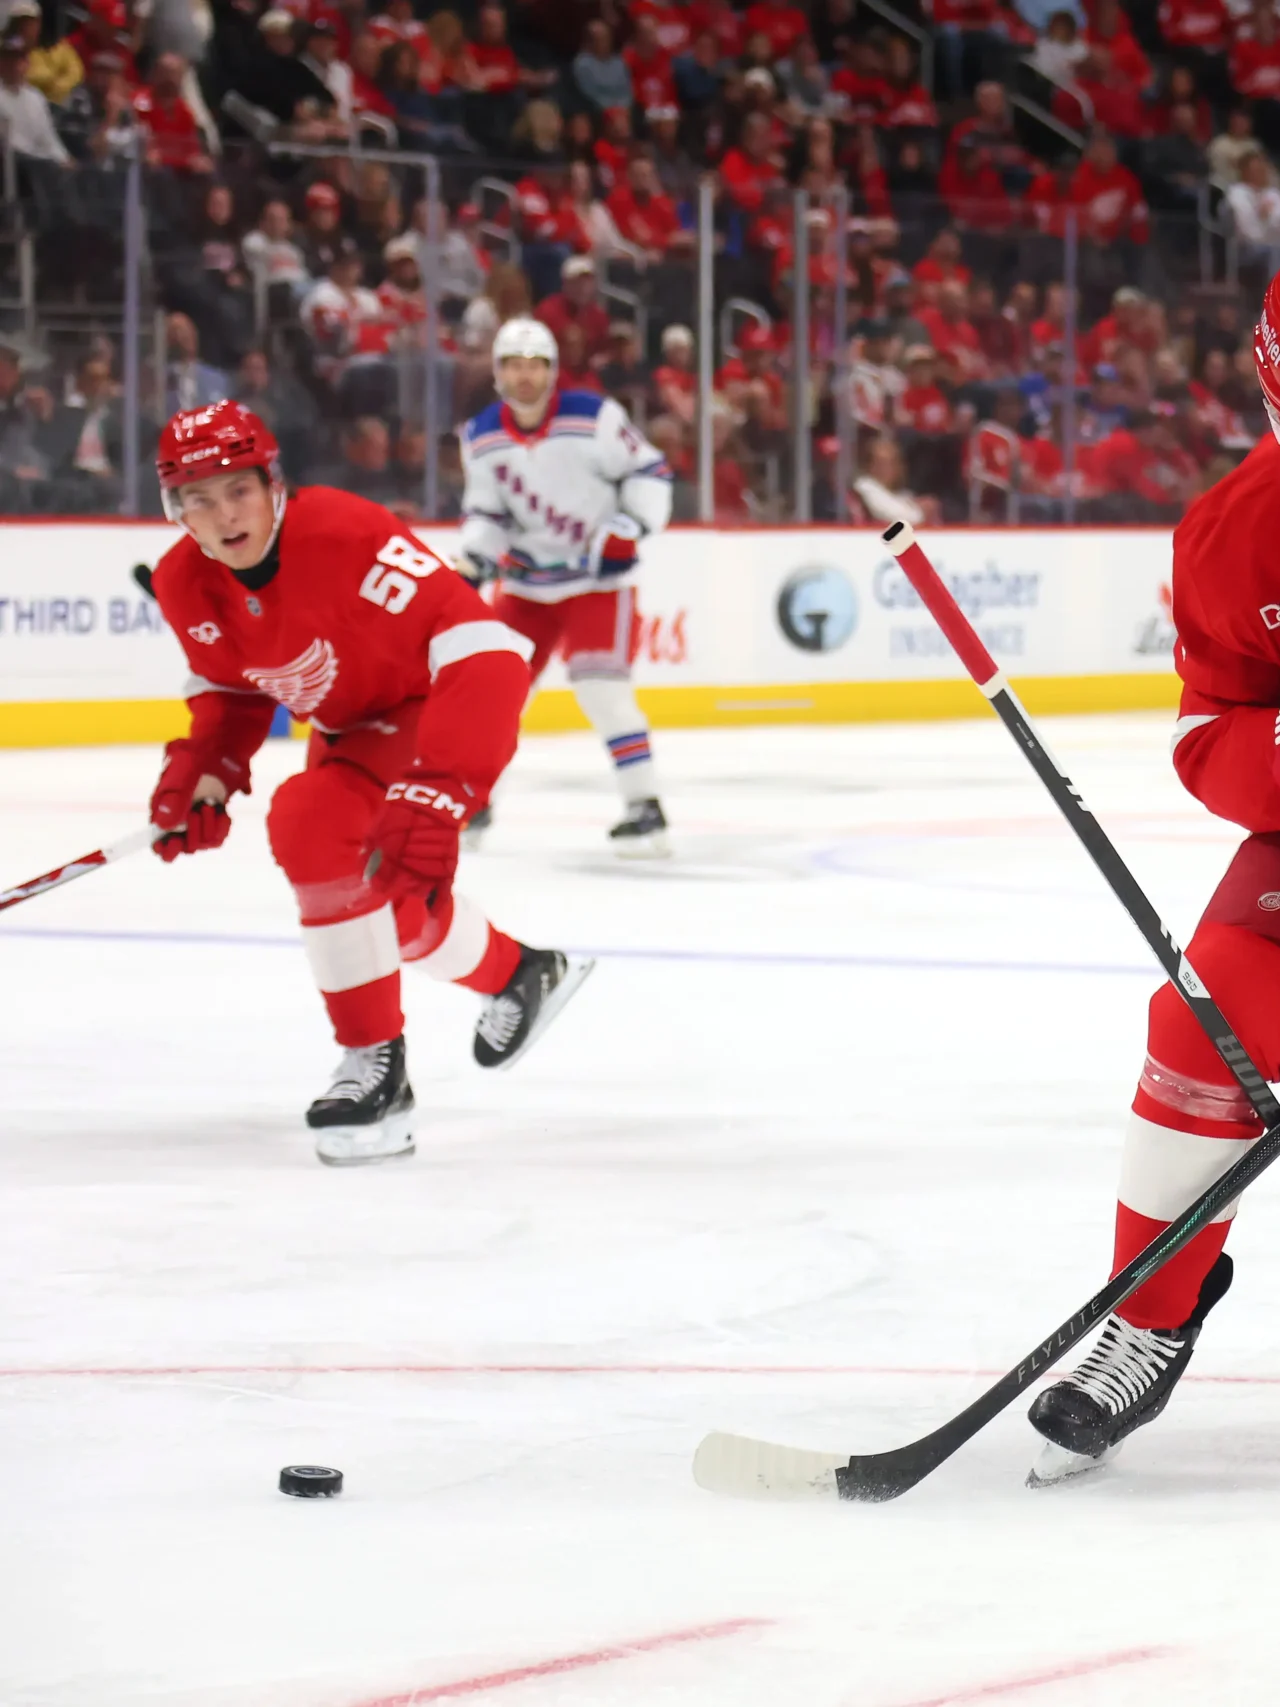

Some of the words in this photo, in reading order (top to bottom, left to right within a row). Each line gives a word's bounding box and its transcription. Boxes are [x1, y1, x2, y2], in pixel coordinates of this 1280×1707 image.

[358, 534, 442, 616] 58
[0, 598, 96, 634] THIRD
[385, 782, 467, 820] CCM
[1016, 1299, 1101, 1385] FLYLITE
